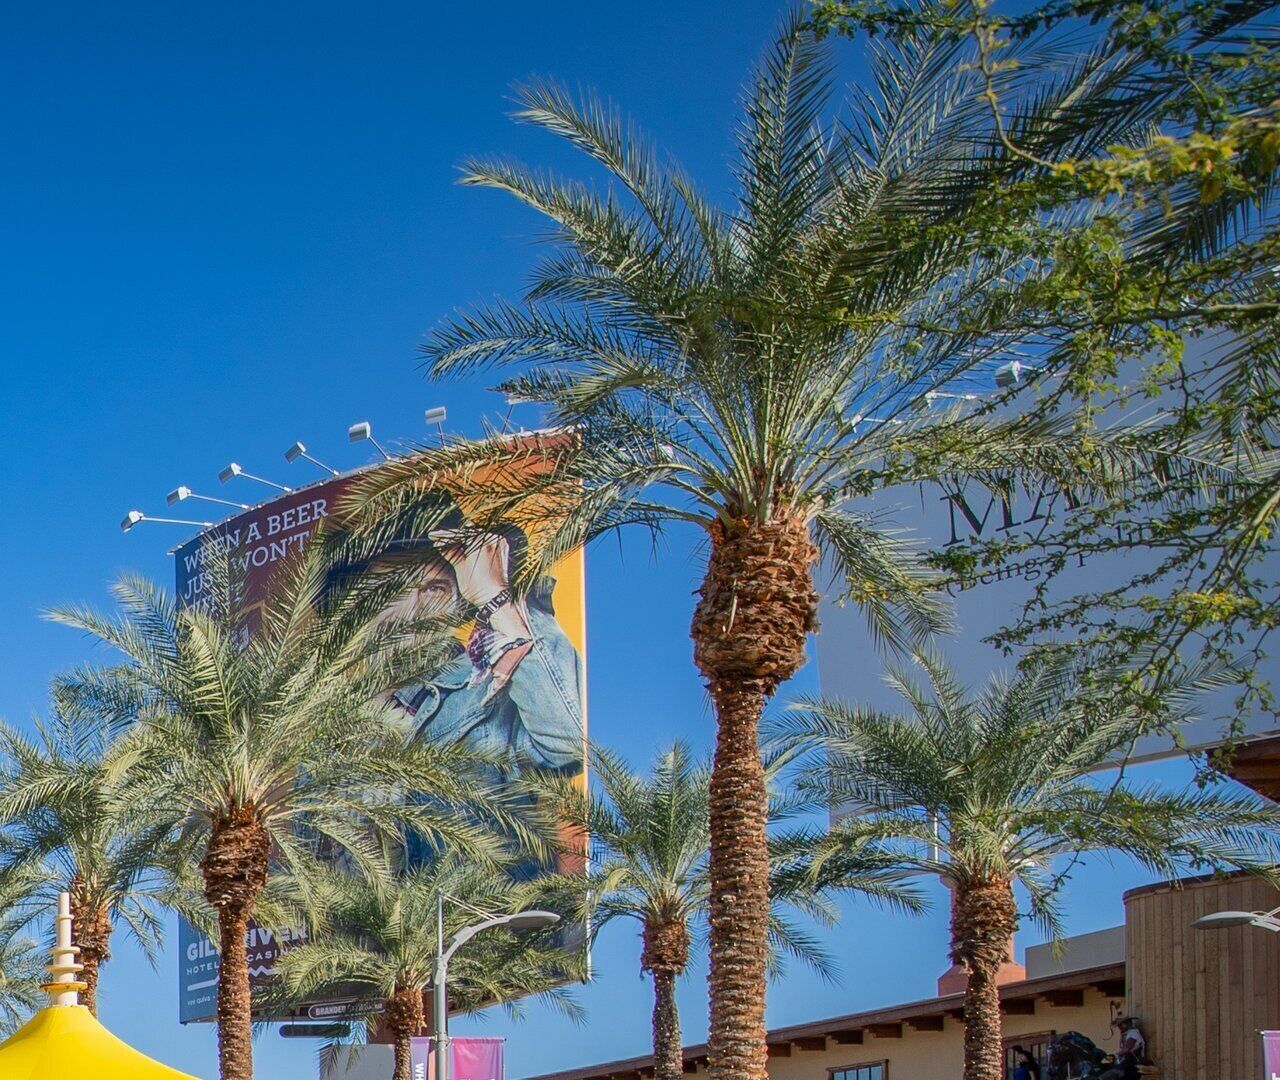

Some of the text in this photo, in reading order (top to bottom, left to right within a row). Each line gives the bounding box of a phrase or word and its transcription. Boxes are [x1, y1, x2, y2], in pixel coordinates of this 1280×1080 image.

[245, 522, 262, 544] A
[267, 499, 329, 536] BEER
[187, 938, 220, 961] GIL
[186, 963, 220, 976] HOTEL
